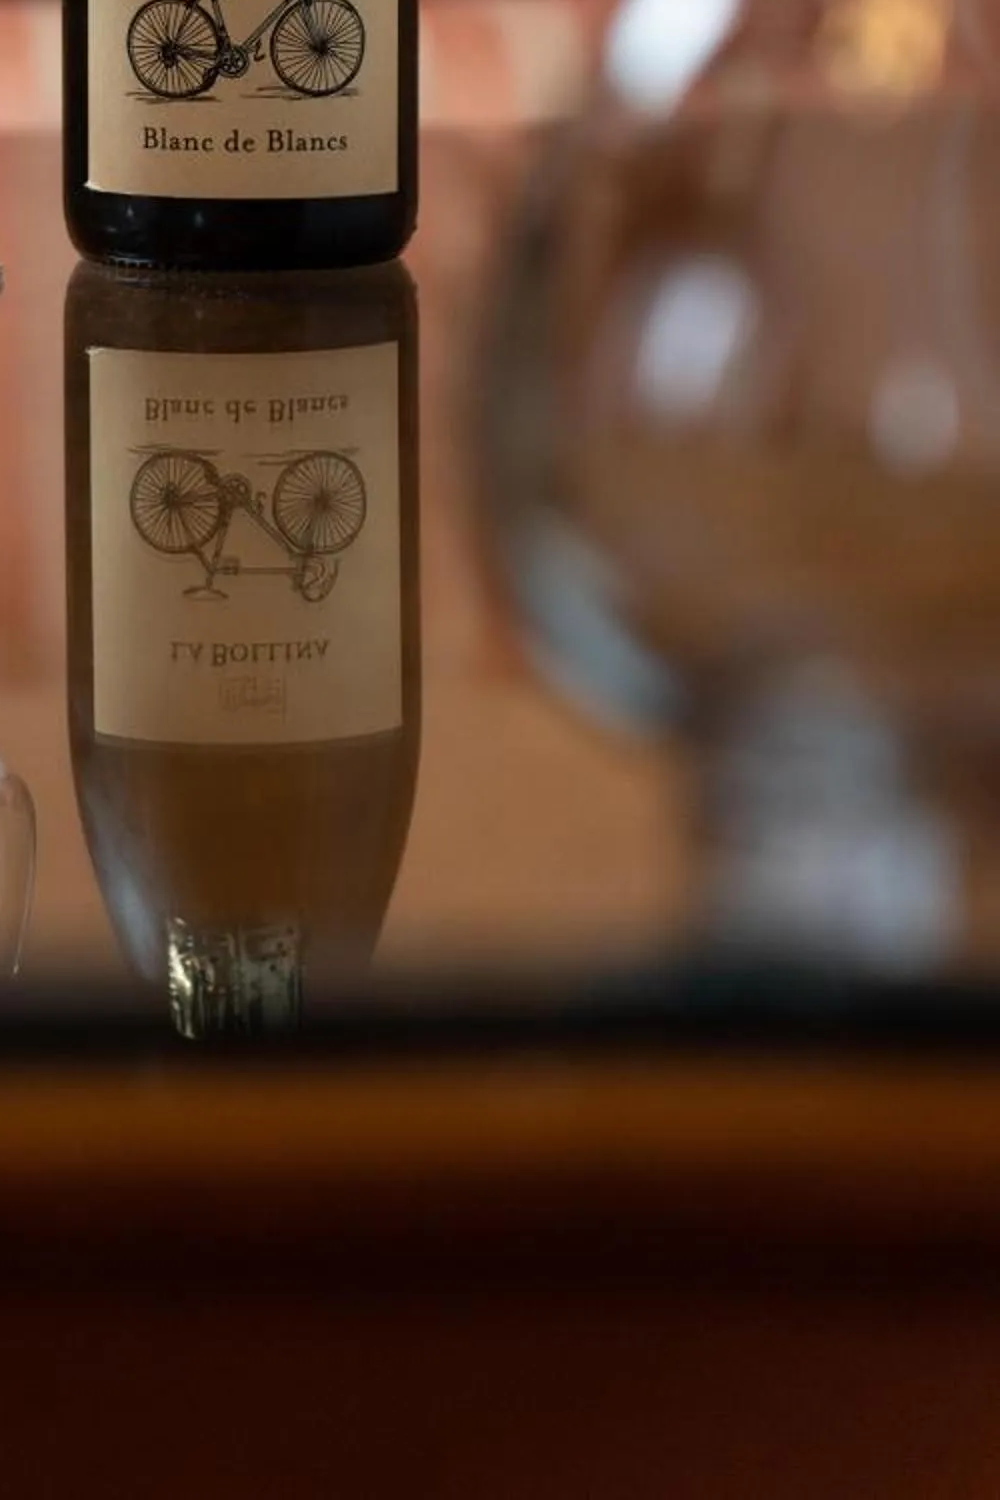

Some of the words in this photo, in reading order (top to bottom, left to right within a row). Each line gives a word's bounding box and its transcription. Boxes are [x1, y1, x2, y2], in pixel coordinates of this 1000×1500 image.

[143, 127, 214, 152] Blanc
[224, 129, 256, 153] de
[267, 129, 348, 153] Blancs
